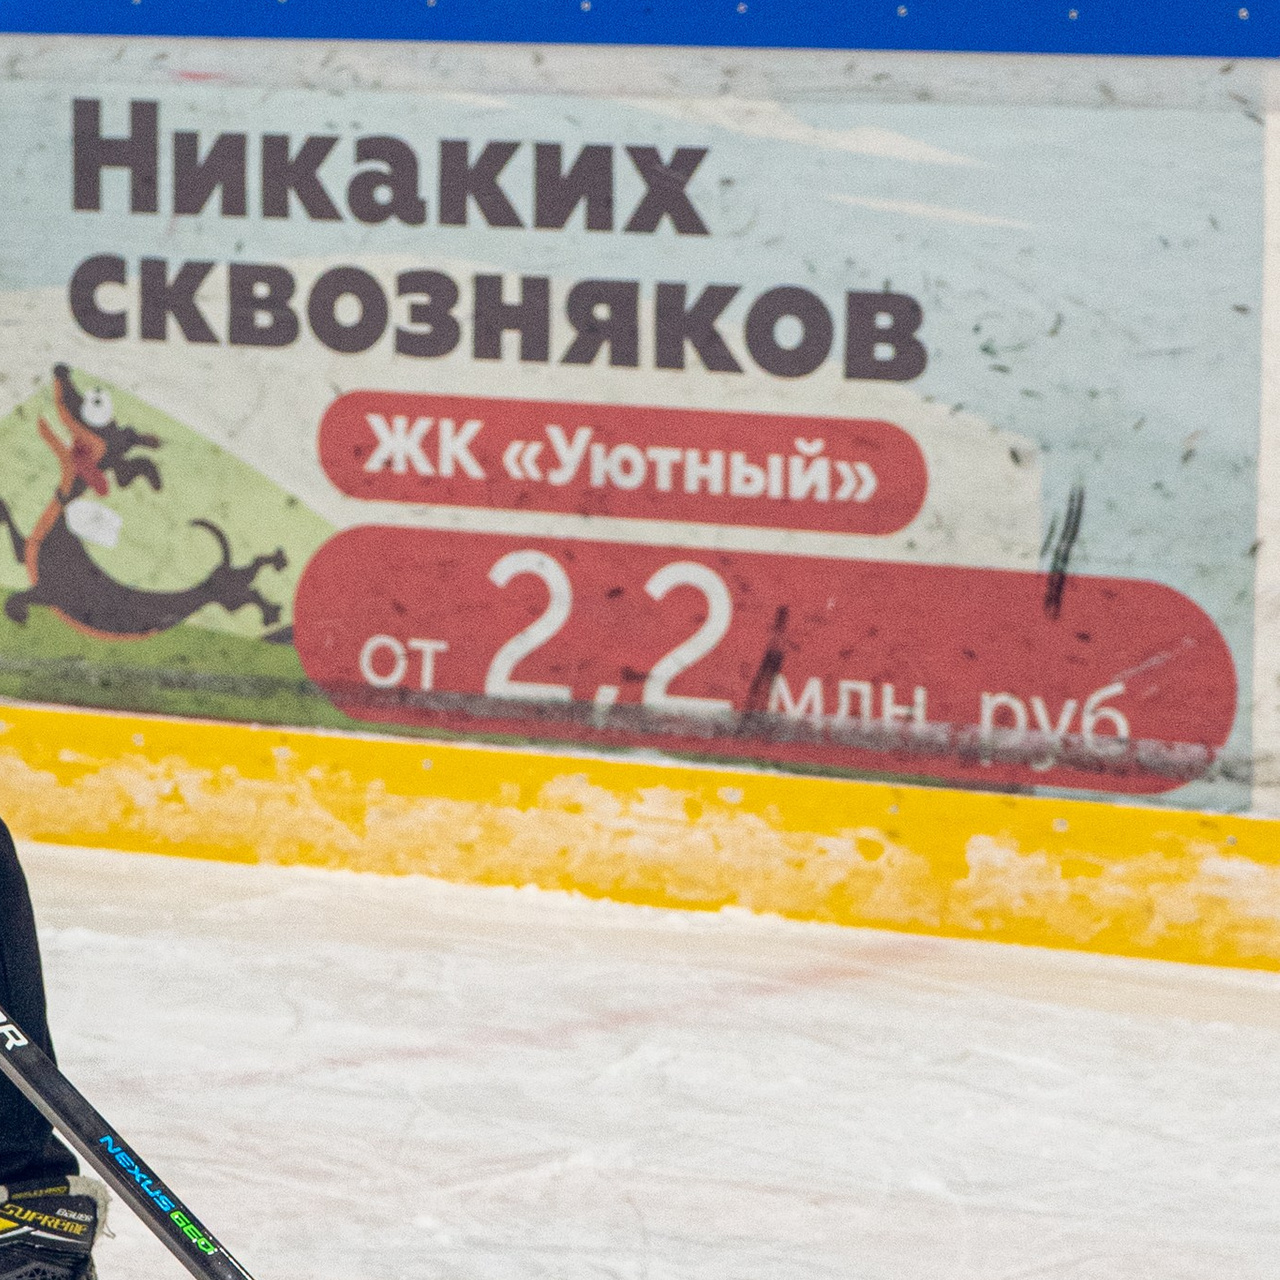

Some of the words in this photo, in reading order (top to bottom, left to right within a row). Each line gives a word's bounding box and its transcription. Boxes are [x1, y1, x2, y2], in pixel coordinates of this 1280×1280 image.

[72, 96, 712, 237] Никаких
[69, 253, 929, 382] сквозняков
[364, 412, 488, 482] ЖК
[502, 424, 880, 504] «Уютный»
[359, 634, 449, 691] от
[484, 549, 733, 730] 2,2
[99, 1134, 177, 1214] NEXUS
[169, 1210, 218, 1255] GEO
